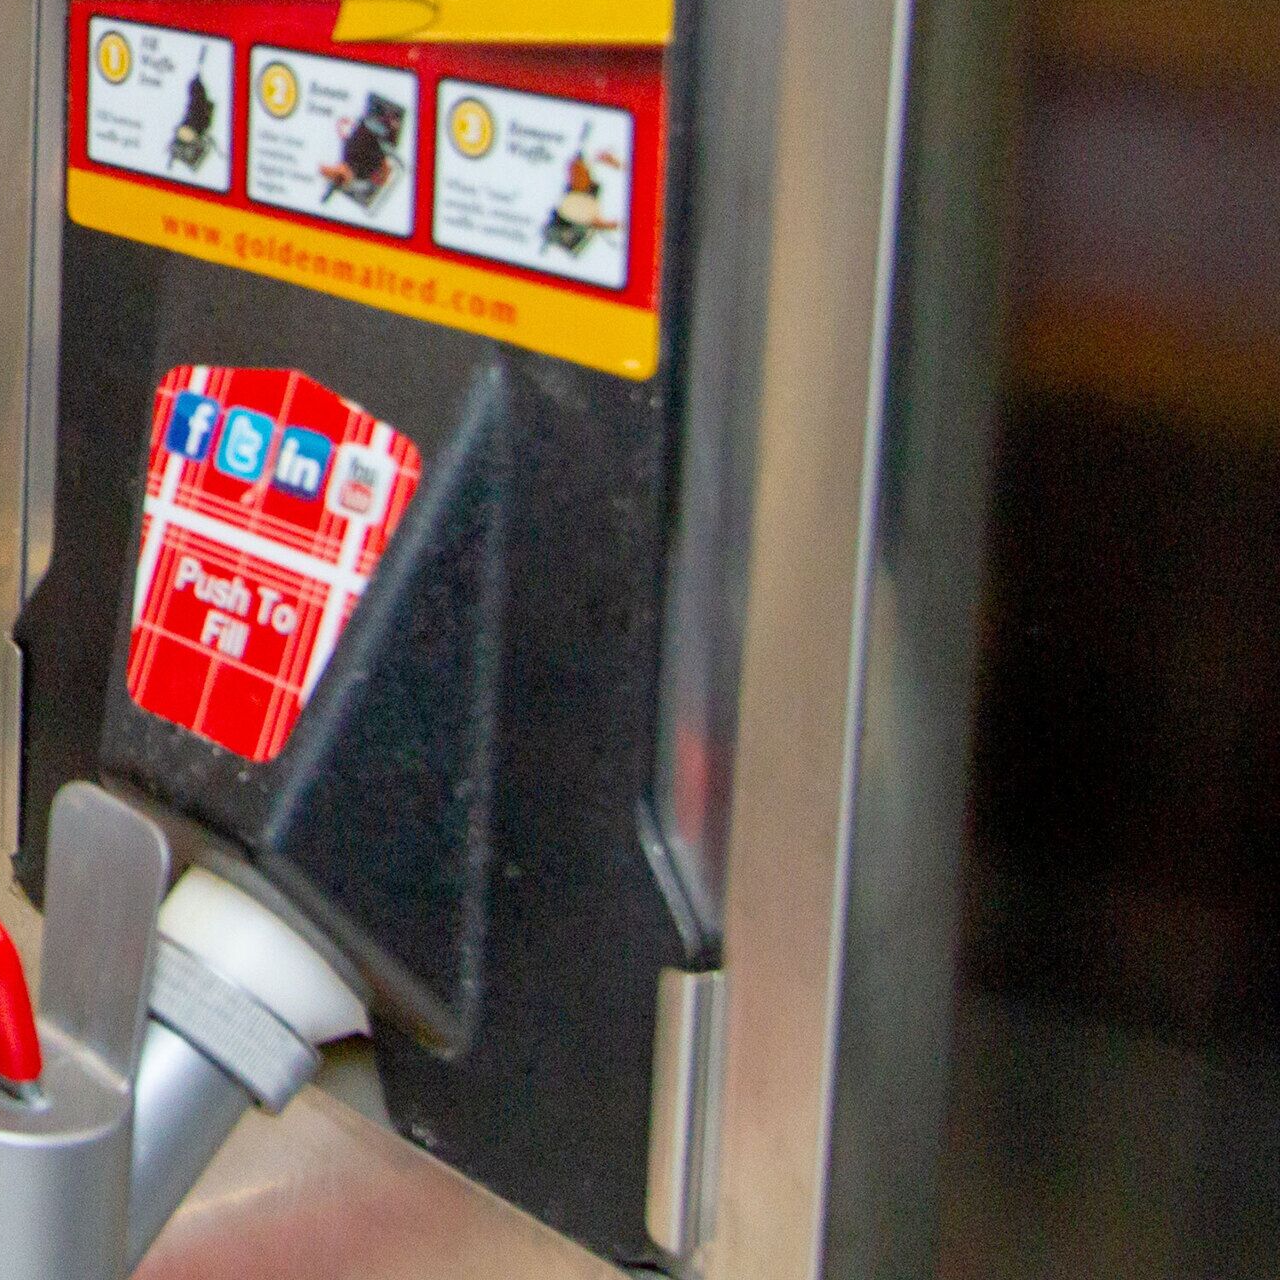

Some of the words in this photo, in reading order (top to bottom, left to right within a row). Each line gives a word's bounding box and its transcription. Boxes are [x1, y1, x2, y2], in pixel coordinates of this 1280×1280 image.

[161, 215, 519, 325] www.goldenmalted.com
[174, 555, 252, 618] Push
[257, 586, 299, 636] To
[200, 609, 250, 659] Fill
